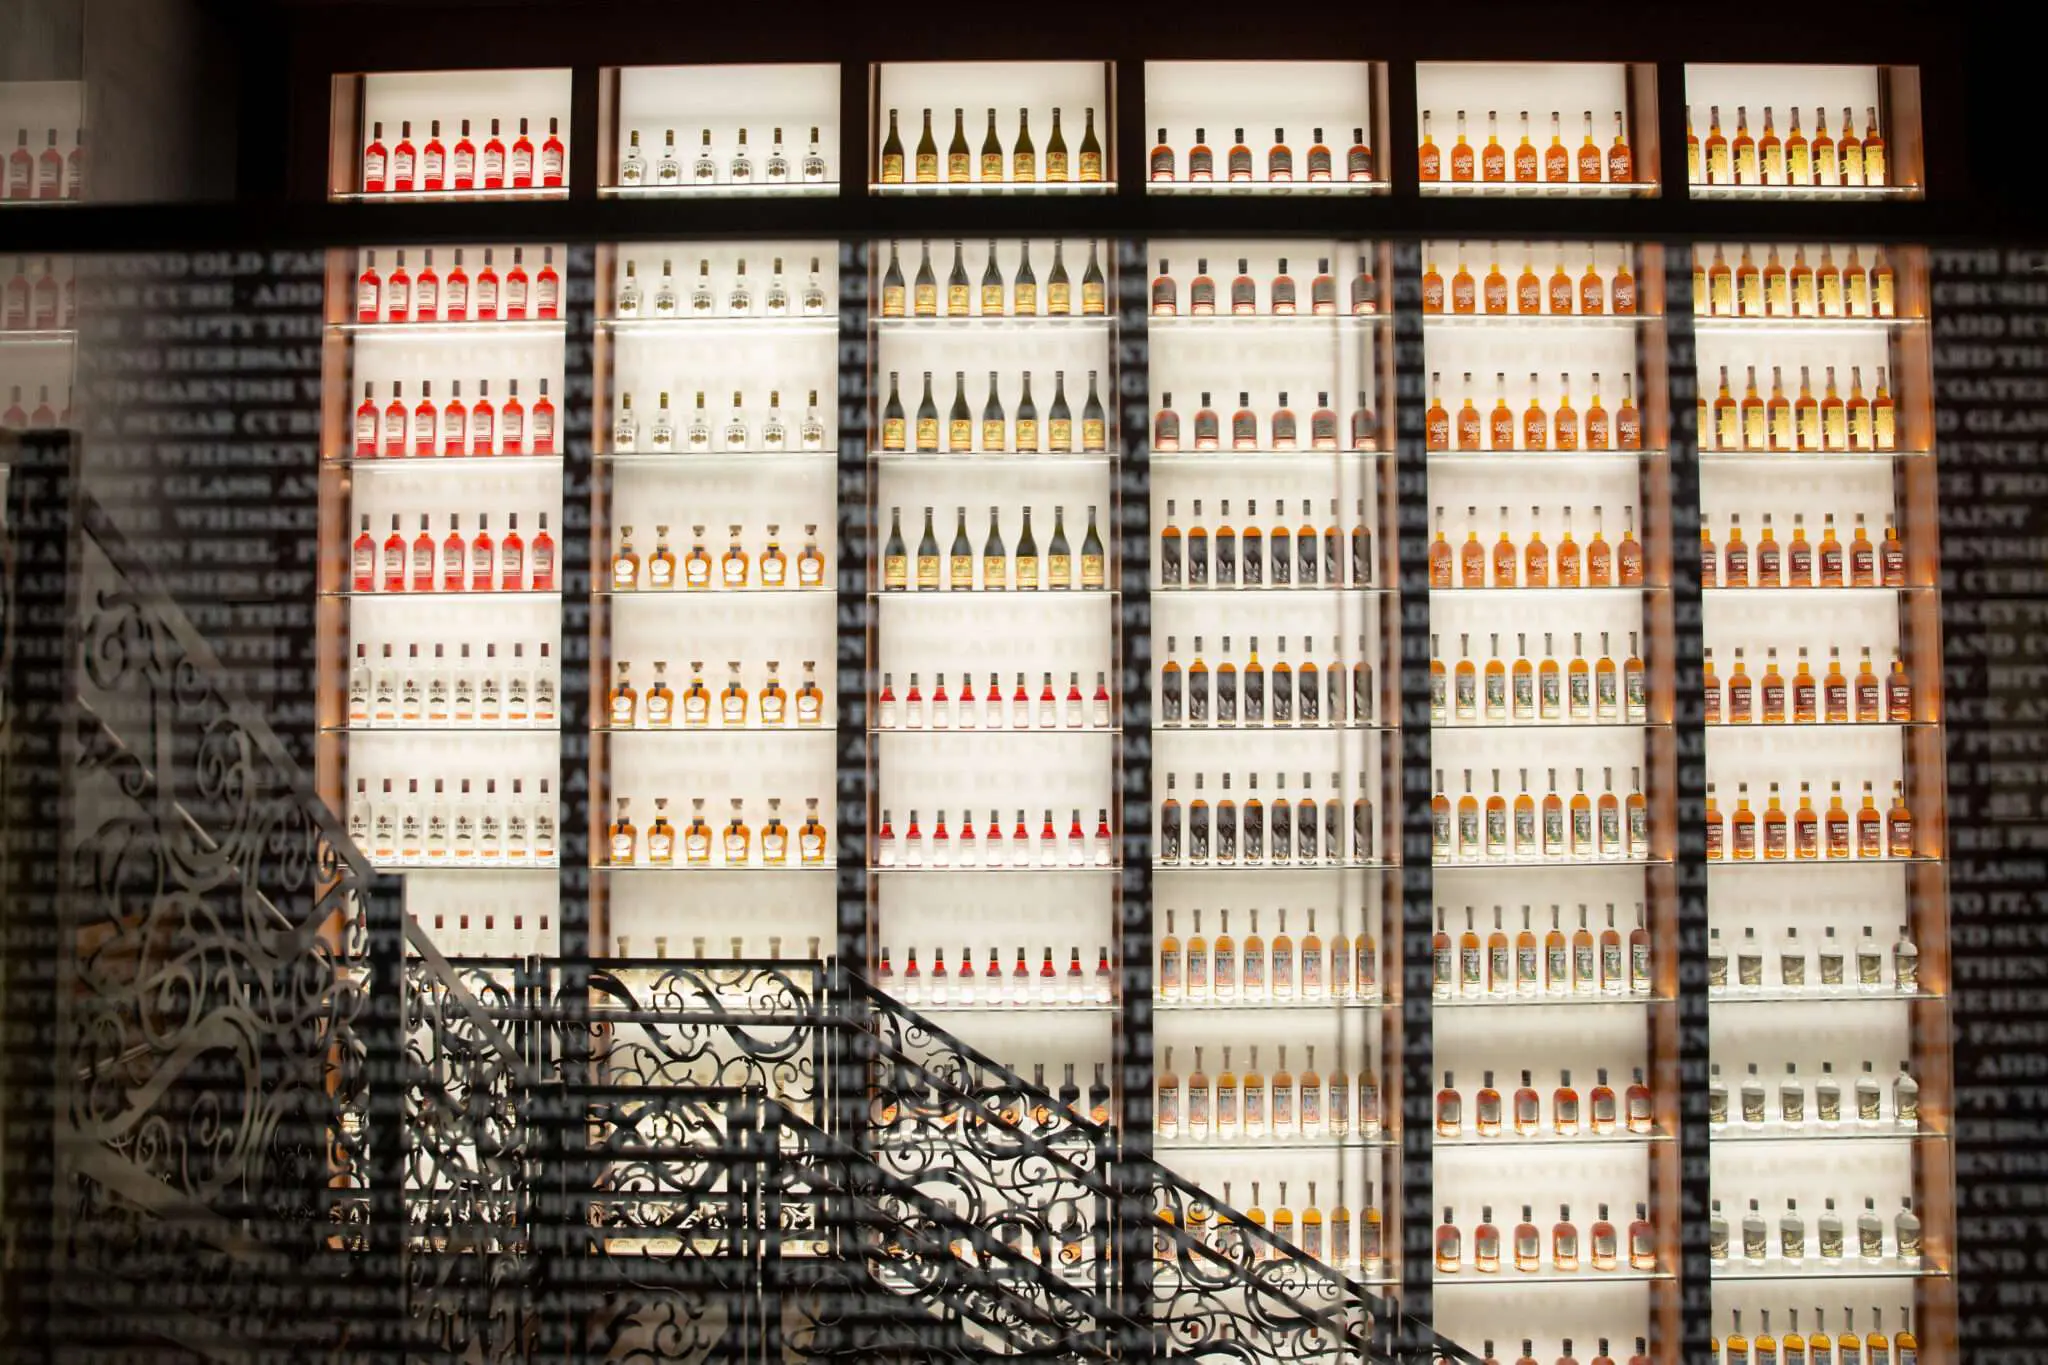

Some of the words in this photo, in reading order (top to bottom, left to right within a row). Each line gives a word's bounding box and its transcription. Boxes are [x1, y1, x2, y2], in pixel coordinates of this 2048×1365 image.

[192, 252, 264, 276] OLD
[252, 284, 322, 308] ADD
[143, 315, 255, 339] EMPTY
[1936, 314, 2004, 337] ADD
[142, 379, 296, 403] GARNISH
[123, 411, 236, 434] SUGAR
[156, 443, 317, 467] WHISKEY
[162, 475, 272, 499] GLASS
[1944, 633, 2015, 656] AND
